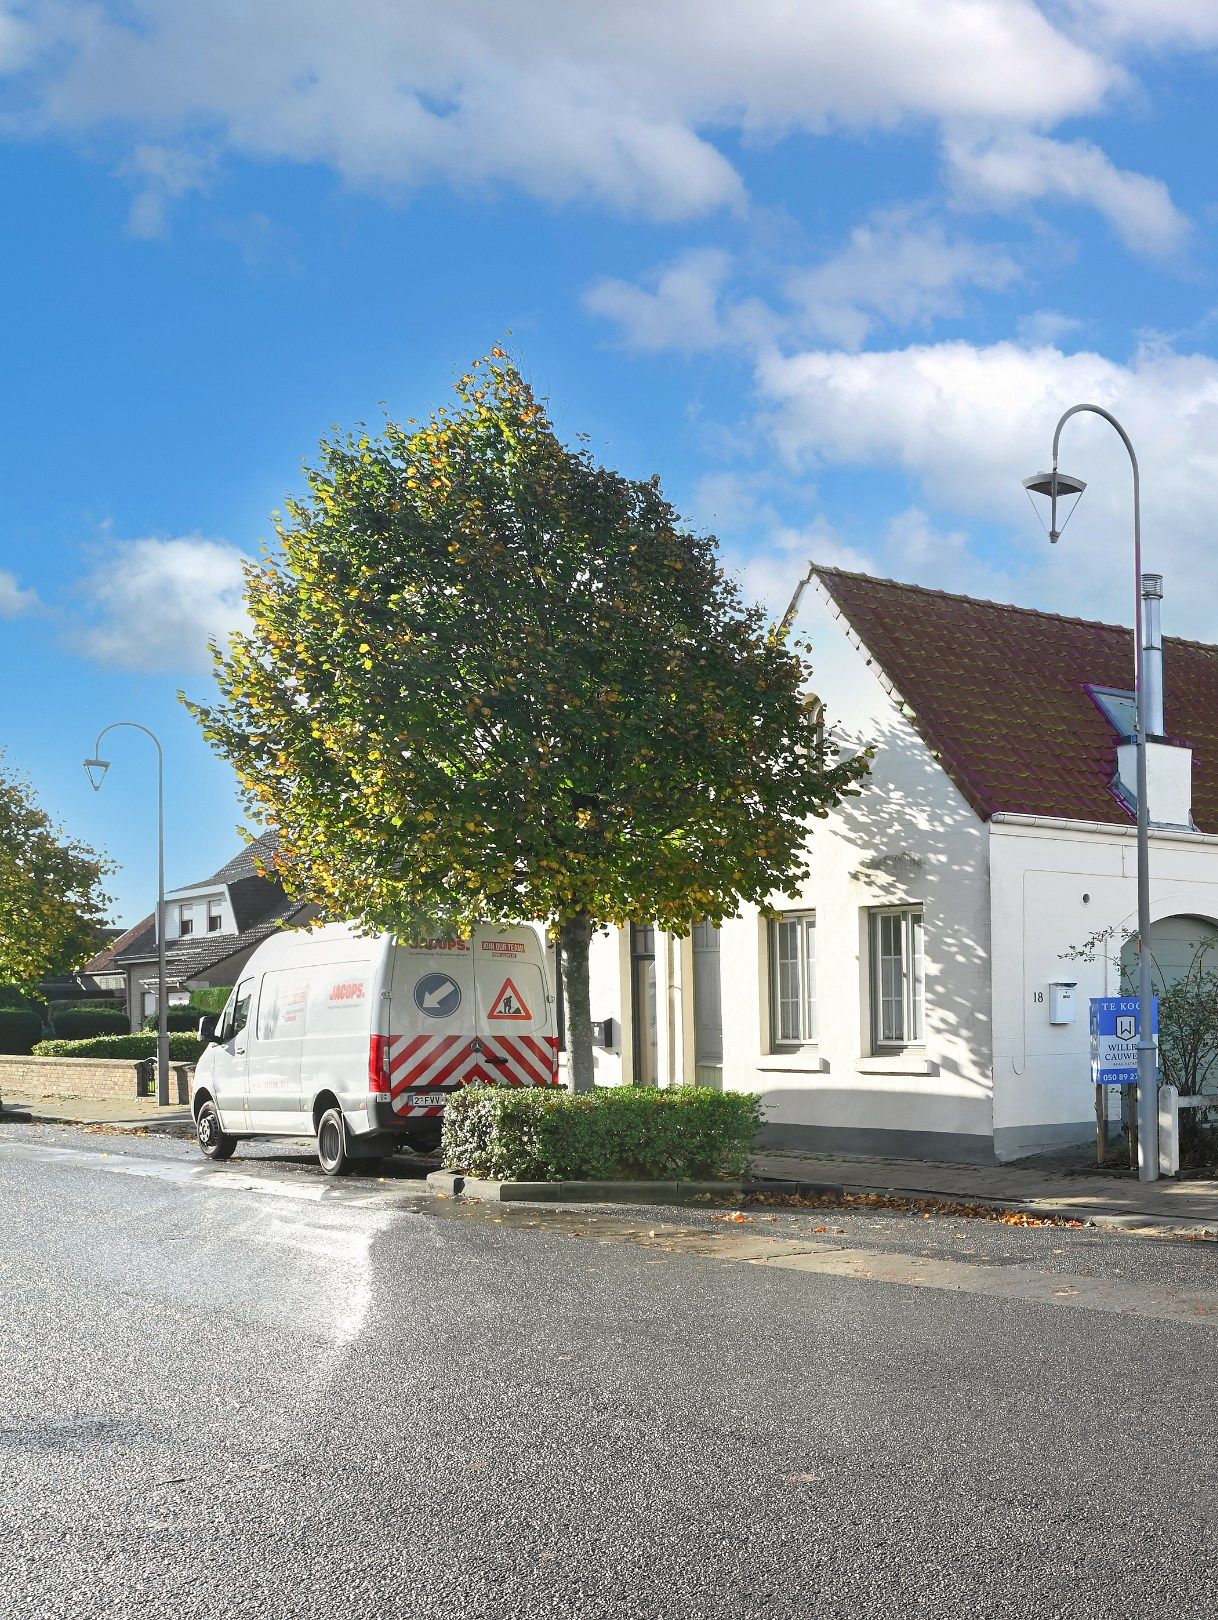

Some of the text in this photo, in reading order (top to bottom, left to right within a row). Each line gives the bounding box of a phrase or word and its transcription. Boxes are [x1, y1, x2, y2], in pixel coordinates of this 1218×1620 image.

[483, 942, 495, 950] JOIN
[495, 942, 507, 951] OUR
[1033, 991, 1044, 1003] 18
[1101, 1002, 1116, 1011] TE
[1107, 1043, 1137, 1052] WILLE
[1104, 1052, 1138, 1061] CAUWE
[1103, 1073, 1117, 1082] 050
[1118, 1073, 1128, 1081] 89
